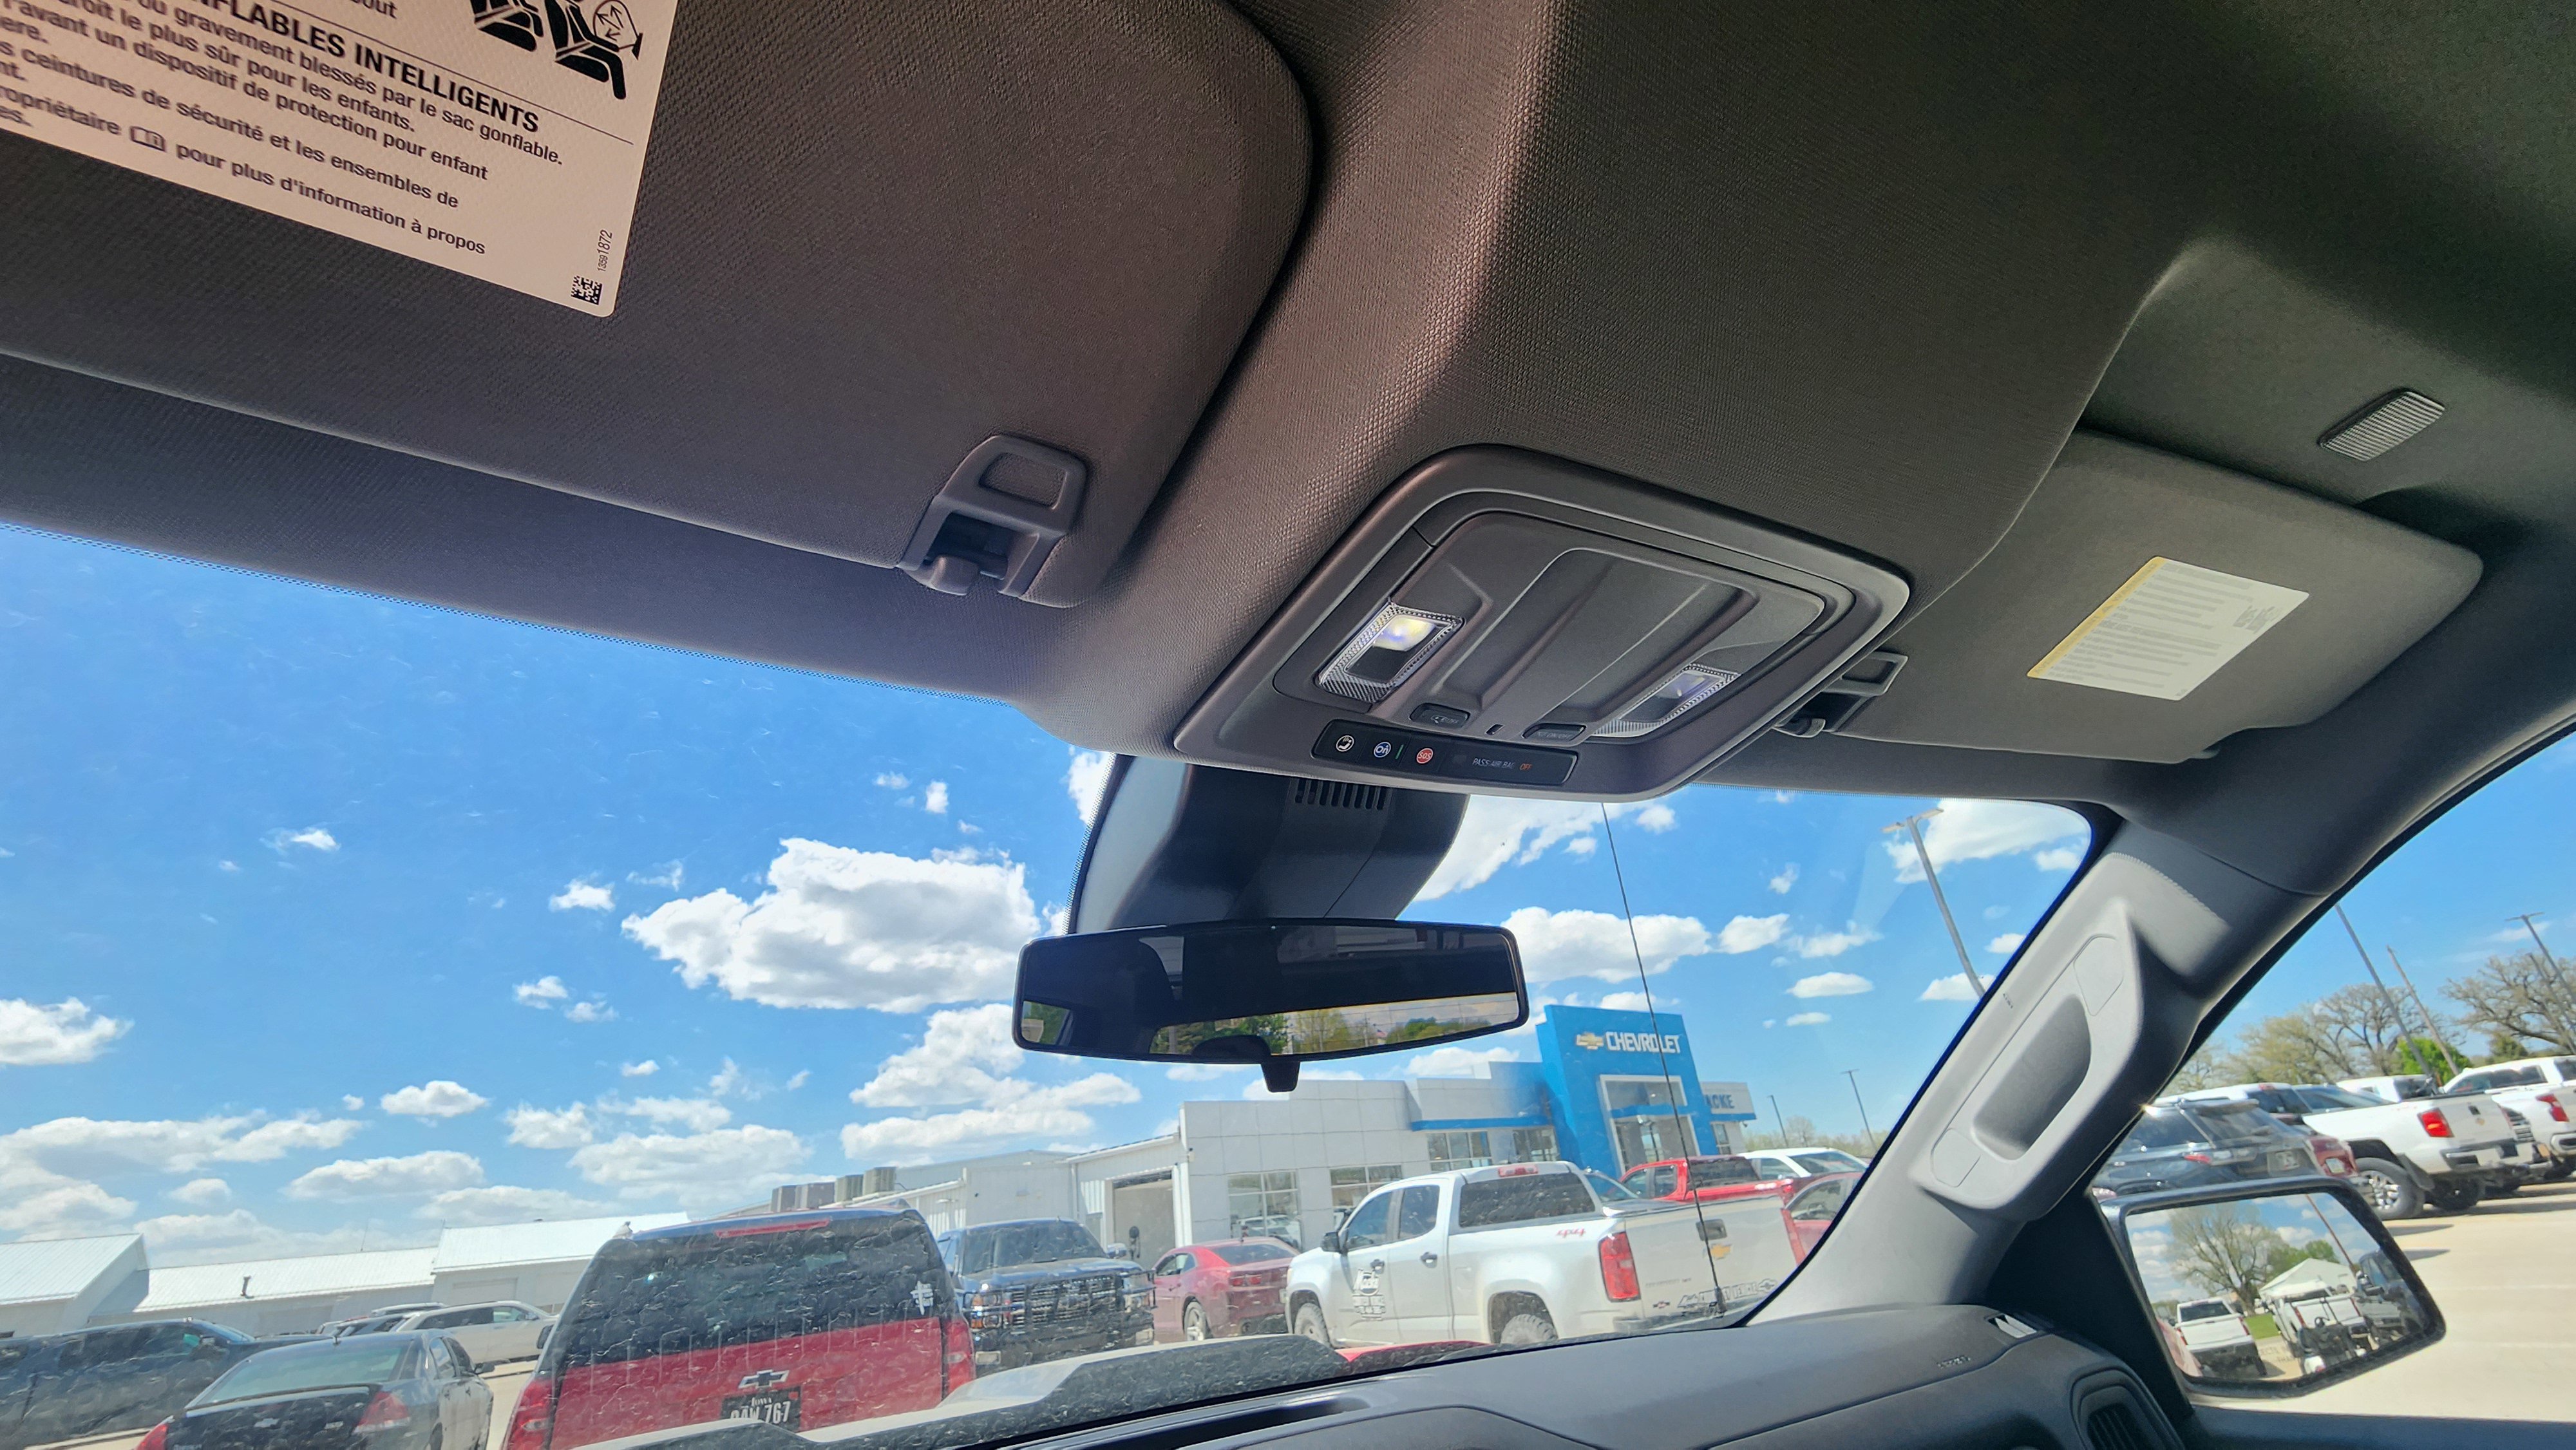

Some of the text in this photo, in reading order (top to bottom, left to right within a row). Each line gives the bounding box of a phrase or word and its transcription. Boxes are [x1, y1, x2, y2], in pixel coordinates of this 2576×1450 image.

[351, 0, 397, 19] out
[95, 28, 126, 50] un
[133, 41, 238, 89] dispositif
[243, 81, 269, 102] de
[276, 94, 377, 140] protection
[383, 132, 426, 157] pour
[431, 151, 488, 180] enfant
[120, 8, 143, 31] le
[149, 23, 198, 52] plus
[204, 42, 242, 67] sûr
[247, 59, 296, 88] pour
[302, 77, 332, 100] les
[337, 94, 415, 132] enfants.
[174, 8, 294, 63] gravement
[299, 51, 377, 95] blessés
[383, 86, 415, 108] par
[420, 99, 437, 117] le
[442, 110, 474, 131] sac
[480, 124, 562, 165] gonflable.
[355, 43, 538, 132] INTELLIGENTS
[21, 48, 135, 97] ceintures
[141, 89, 171, 109] de
[176, 102, 263, 141] sécurité
[270, 134, 292, 151] et
[296, 139, 325, 162] les
[330, 155, 431, 199] ensembles
[437, 191, 459, 208] de
[176, 143, 227, 169] pour
[231, 162, 274, 185] plus
[279, 178, 406, 229] d'information
[411, 218, 422, 234] à
[428, 227, 485, 254] propos
[596, 229, 612, 271] 13591872
[1472, 758, 1490, 766] PASS
[1605, 1031, 1680, 1053] CHEVROLET
[764, 1401, 791, 1424] 767
